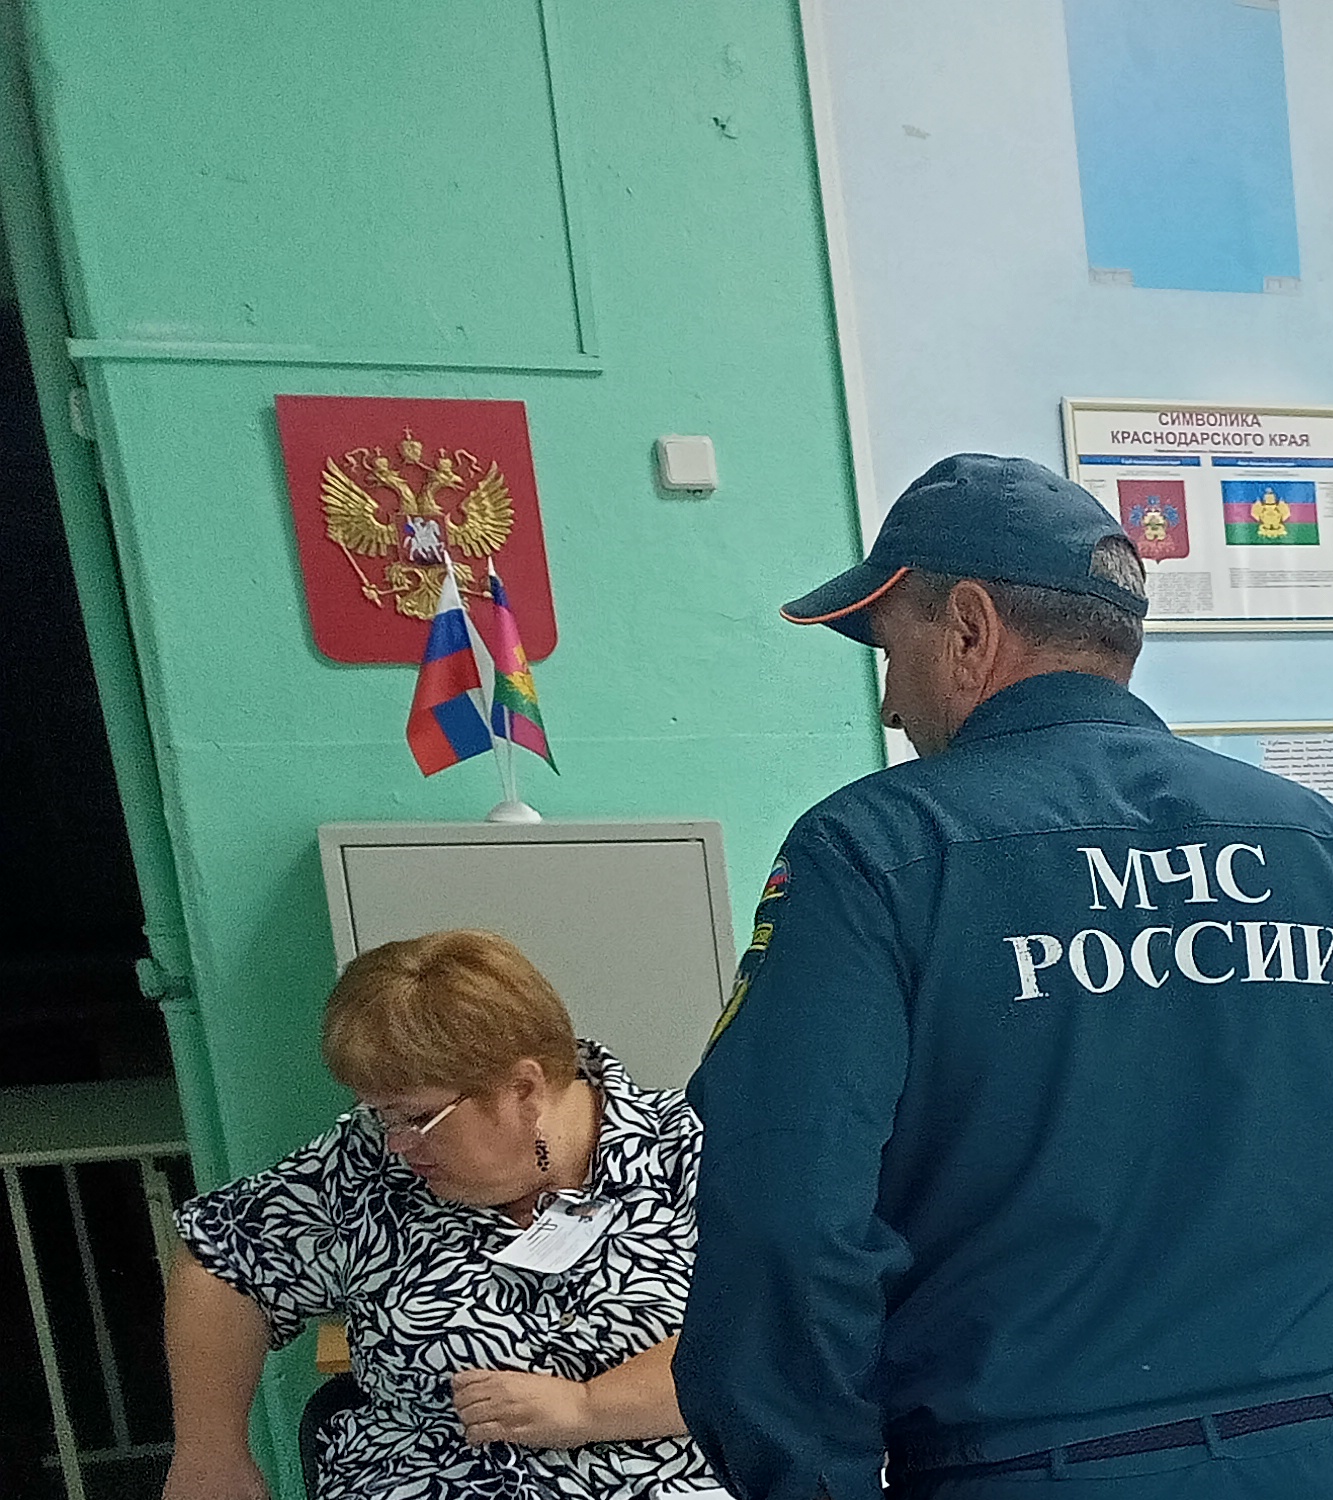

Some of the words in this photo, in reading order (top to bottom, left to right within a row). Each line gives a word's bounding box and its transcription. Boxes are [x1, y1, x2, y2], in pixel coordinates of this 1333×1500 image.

[1158, 412, 1262, 429] СИМВОЛИКА
[1111, 430, 1265, 448] КРАСНОДАРСКОГО
[1268, 433, 1311, 448] КРАЯ
[1076, 843, 1272, 910] МЧС
